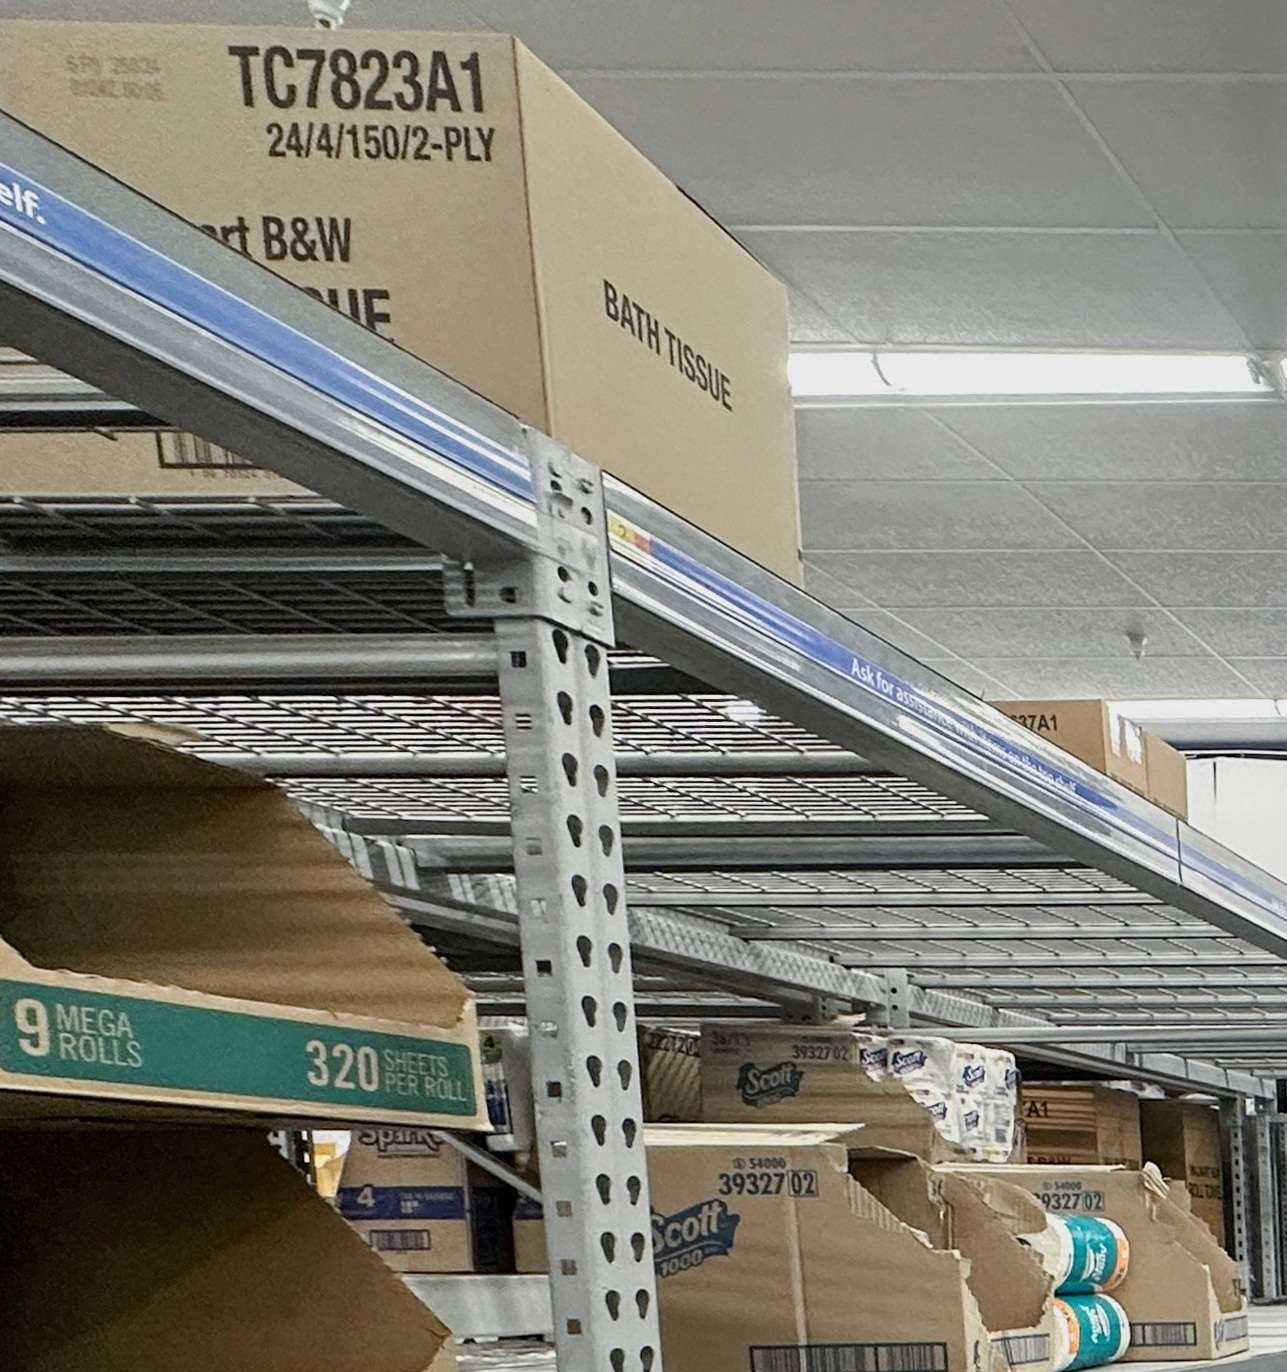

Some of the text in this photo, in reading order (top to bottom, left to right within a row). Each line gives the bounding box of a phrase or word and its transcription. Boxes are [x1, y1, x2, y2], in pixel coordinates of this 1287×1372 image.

[228, 45, 485, 113] TC7823A1
[266, 122, 495, 162] 24/4/150/2-PLY
[263, 216, 351, 262] B&W
[603, 279, 732, 412] BATH TISSUE
[850, 658, 875, 688] Ask
[876, 671, 894, 696] for
[14, 998, 134, 1058] 9 MEGA
[59, 1031, 143, 1069] ROLLS
[306, 1039, 449, 1092] 320 SHEETS
[384, 1071, 467, 1102] PER ROLL
[745, 1064, 794, 1096] Scott
[357, 1184, 376, 1208] 4
[718, 1172, 815, 1196] 39327 02
[1082, 1192, 1103, 1211] 02
[652, 1200, 723, 1253] Scott
[660, 1248, 704, 1279] 1000
